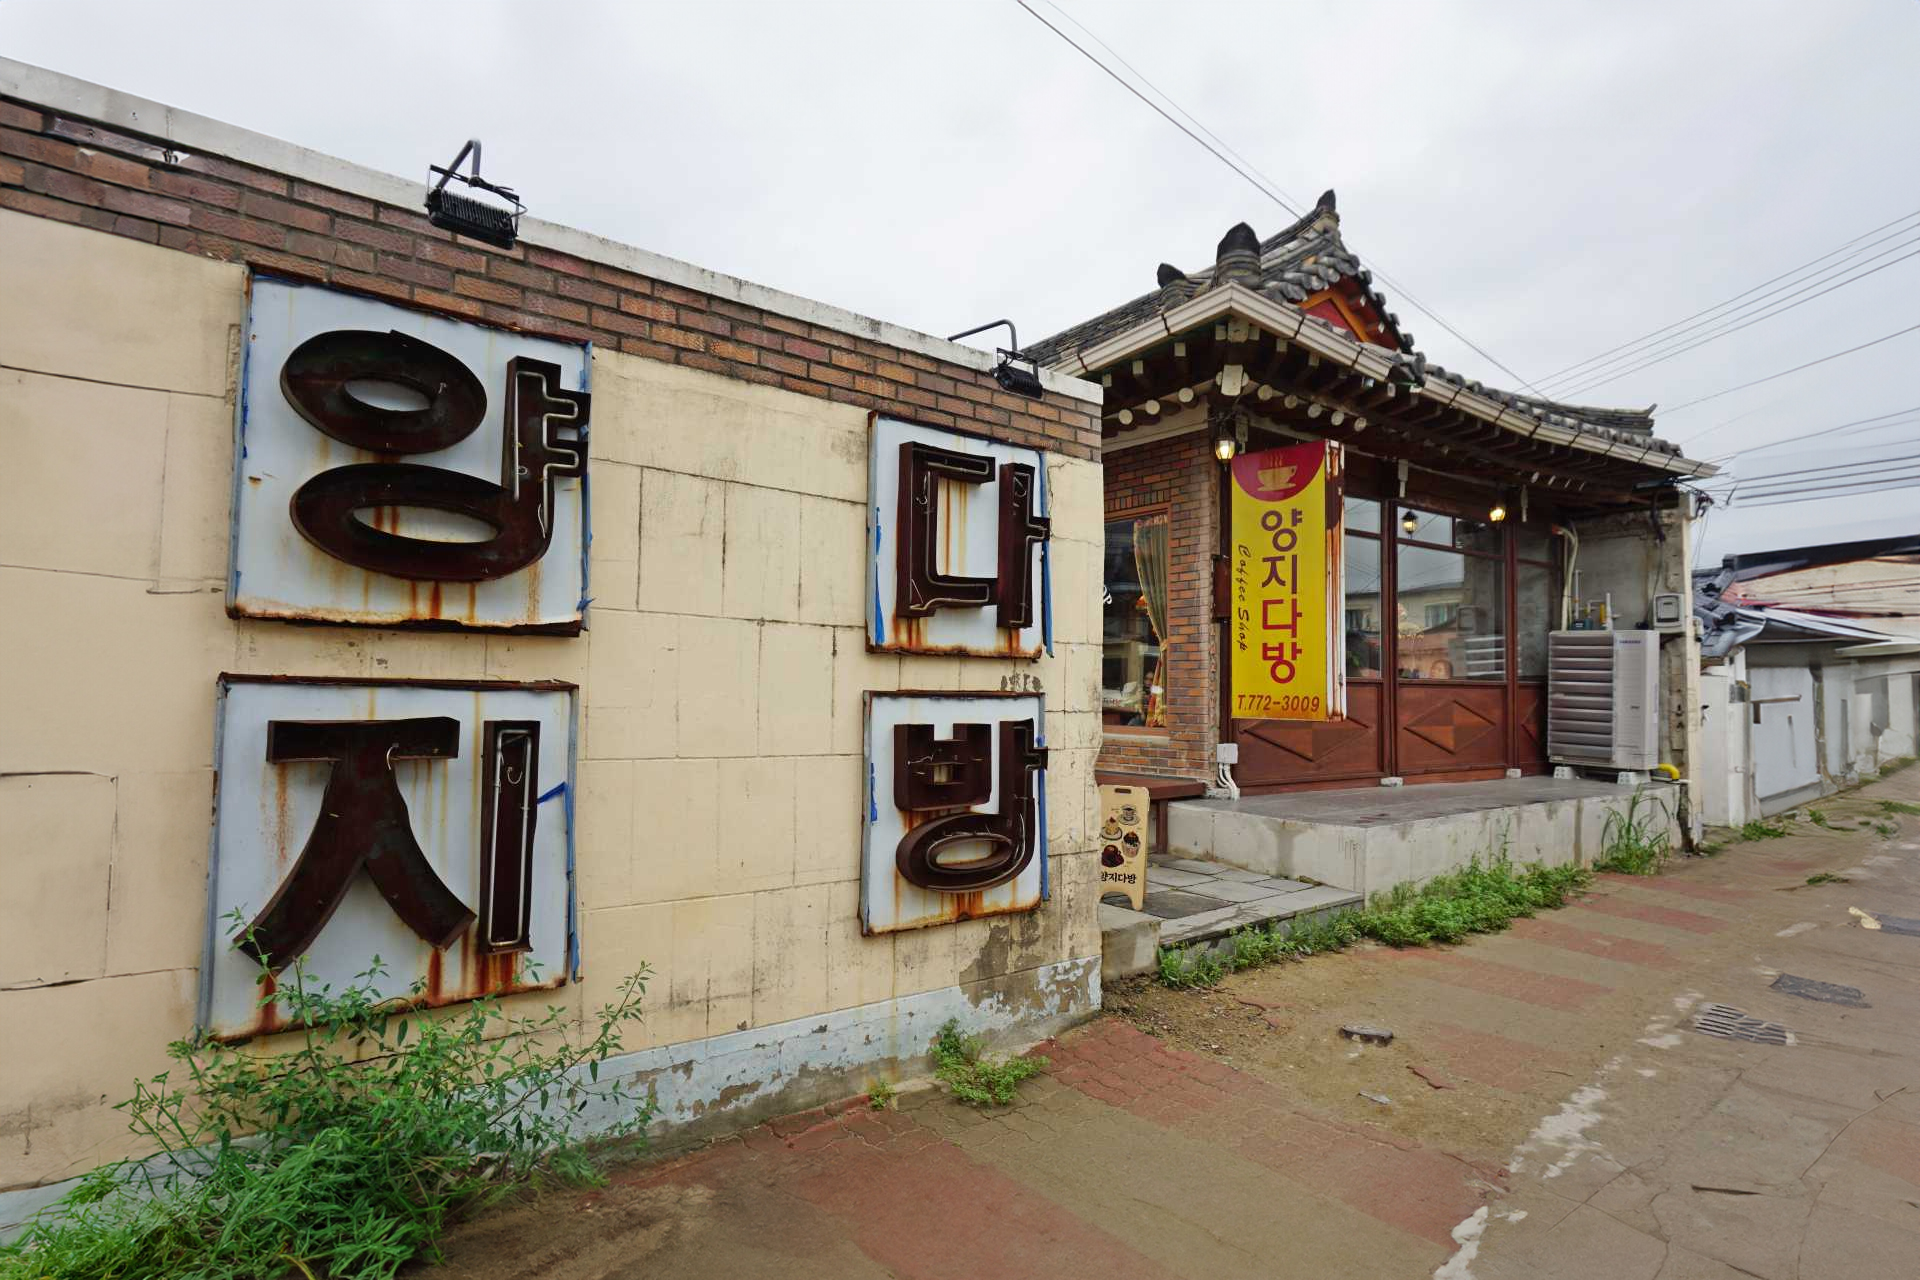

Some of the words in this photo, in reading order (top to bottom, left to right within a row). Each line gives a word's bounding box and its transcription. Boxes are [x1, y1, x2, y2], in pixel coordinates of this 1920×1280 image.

[1238, 607, 1250, 651] Shop
[1261, 508, 1303, 684] 양지다방
[895, 441, 1050, 893] 다방
[1238, 695, 1319, 712] T.772-3009
